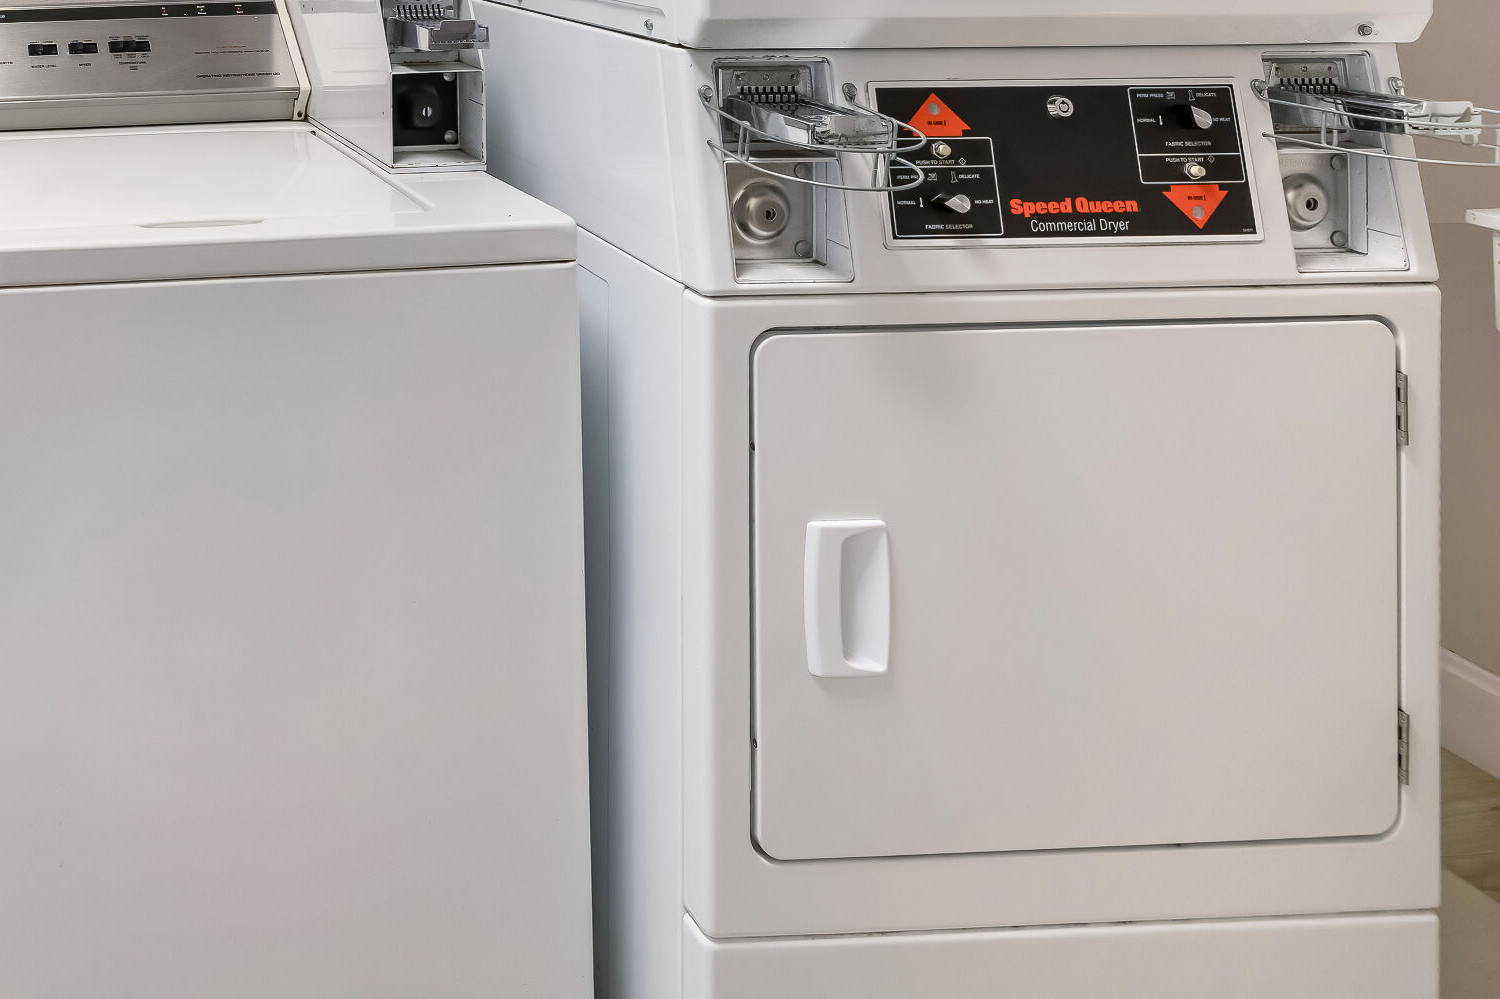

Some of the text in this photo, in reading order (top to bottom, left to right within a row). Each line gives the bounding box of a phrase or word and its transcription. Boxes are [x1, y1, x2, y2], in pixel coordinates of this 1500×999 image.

[1010, 197, 1138, 217] Speed Queen
[1030, 219, 1130, 233] Commercial Dryer
